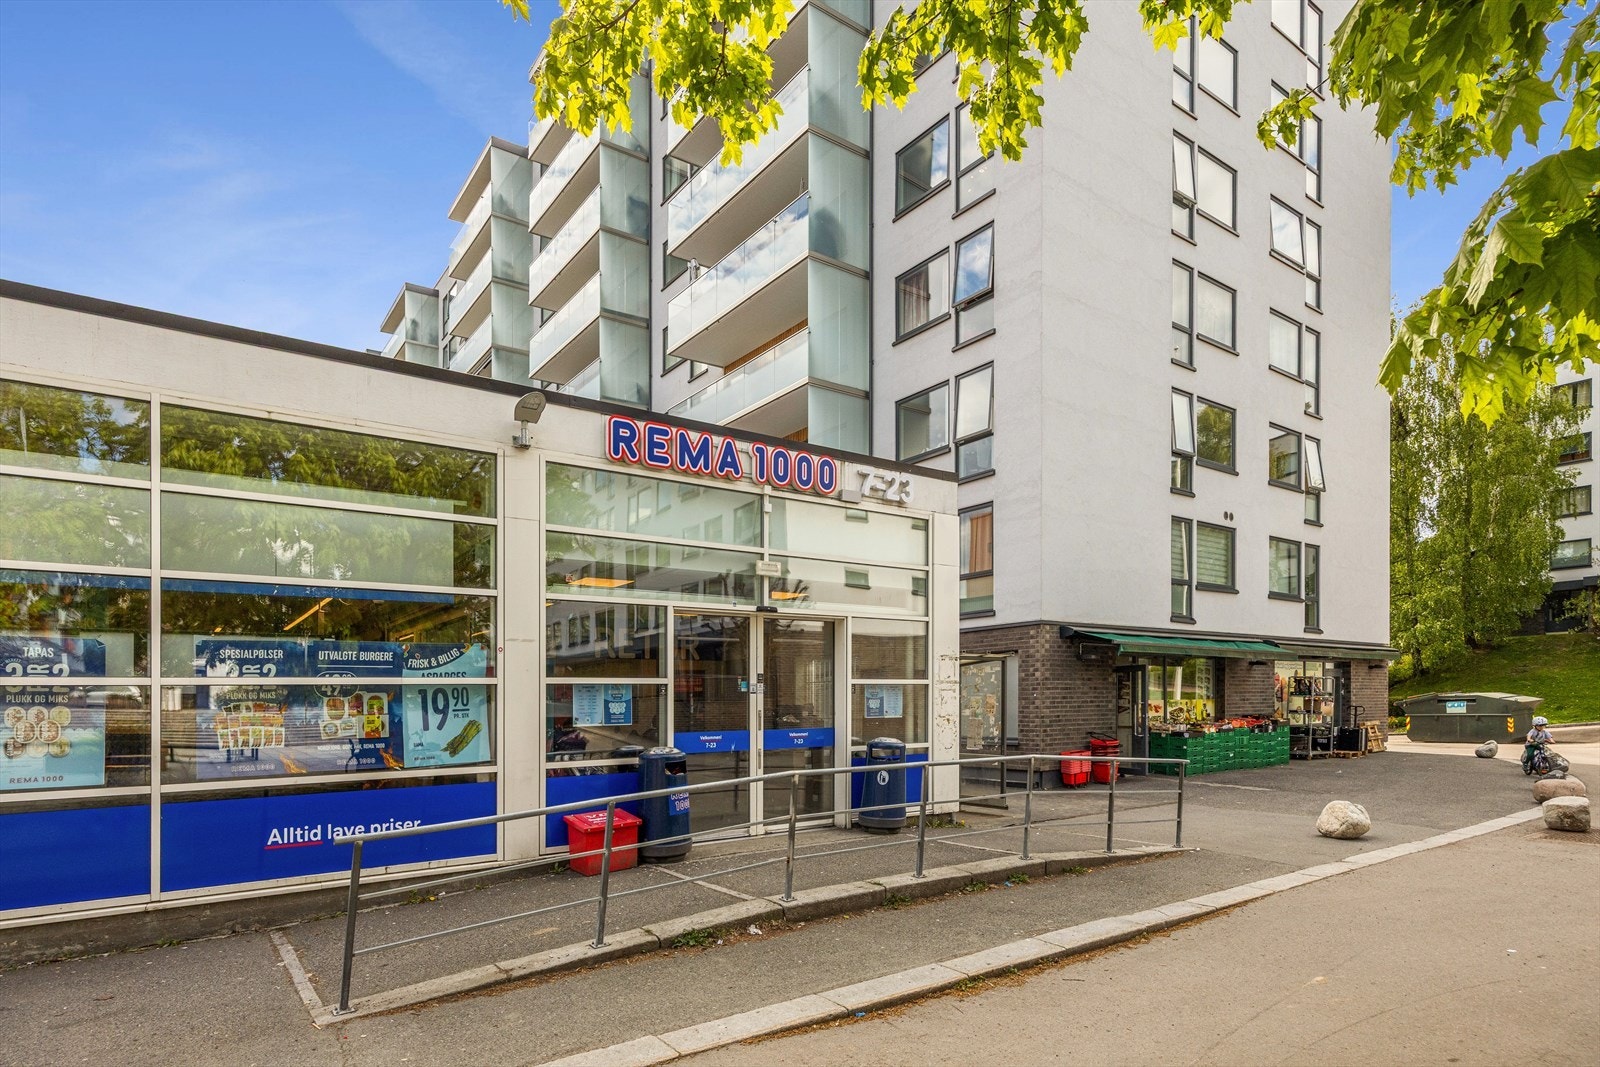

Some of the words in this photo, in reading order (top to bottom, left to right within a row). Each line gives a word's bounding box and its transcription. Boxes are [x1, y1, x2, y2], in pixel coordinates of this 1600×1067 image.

[606, 414, 744, 480] REMA
[751, 441, 838, 495] 1000
[857, 466, 914, 503] 7-23
[23, 647, 54, 658] TAPAS
[219, 649, 284, 659] SPESIALPØLSER
[594, 627, 700, 660] RETR
[318, 650, 358, 661] UTVALGTE
[359, 651, 394, 661] BURGERE
[407, 658, 429, 669] FRISK
[430, 656, 438, 667] &
[437, 648, 460, 665] BILLIG
[52, 662, 70, 692] 2
[262, 663, 277, 690] 2
[6, 694, 32, 703] PLUKK
[34, 694, 46, 703] OG
[48, 694, 69, 703] MIKS
[417, 687, 450, 732] 19
[451, 686, 470, 708] 90
[9, 776, 39, 784] REMA
[42, 775, 64, 783] 1000
[267, 825, 322, 846] Alltid
[327, 823, 365, 840] lave
